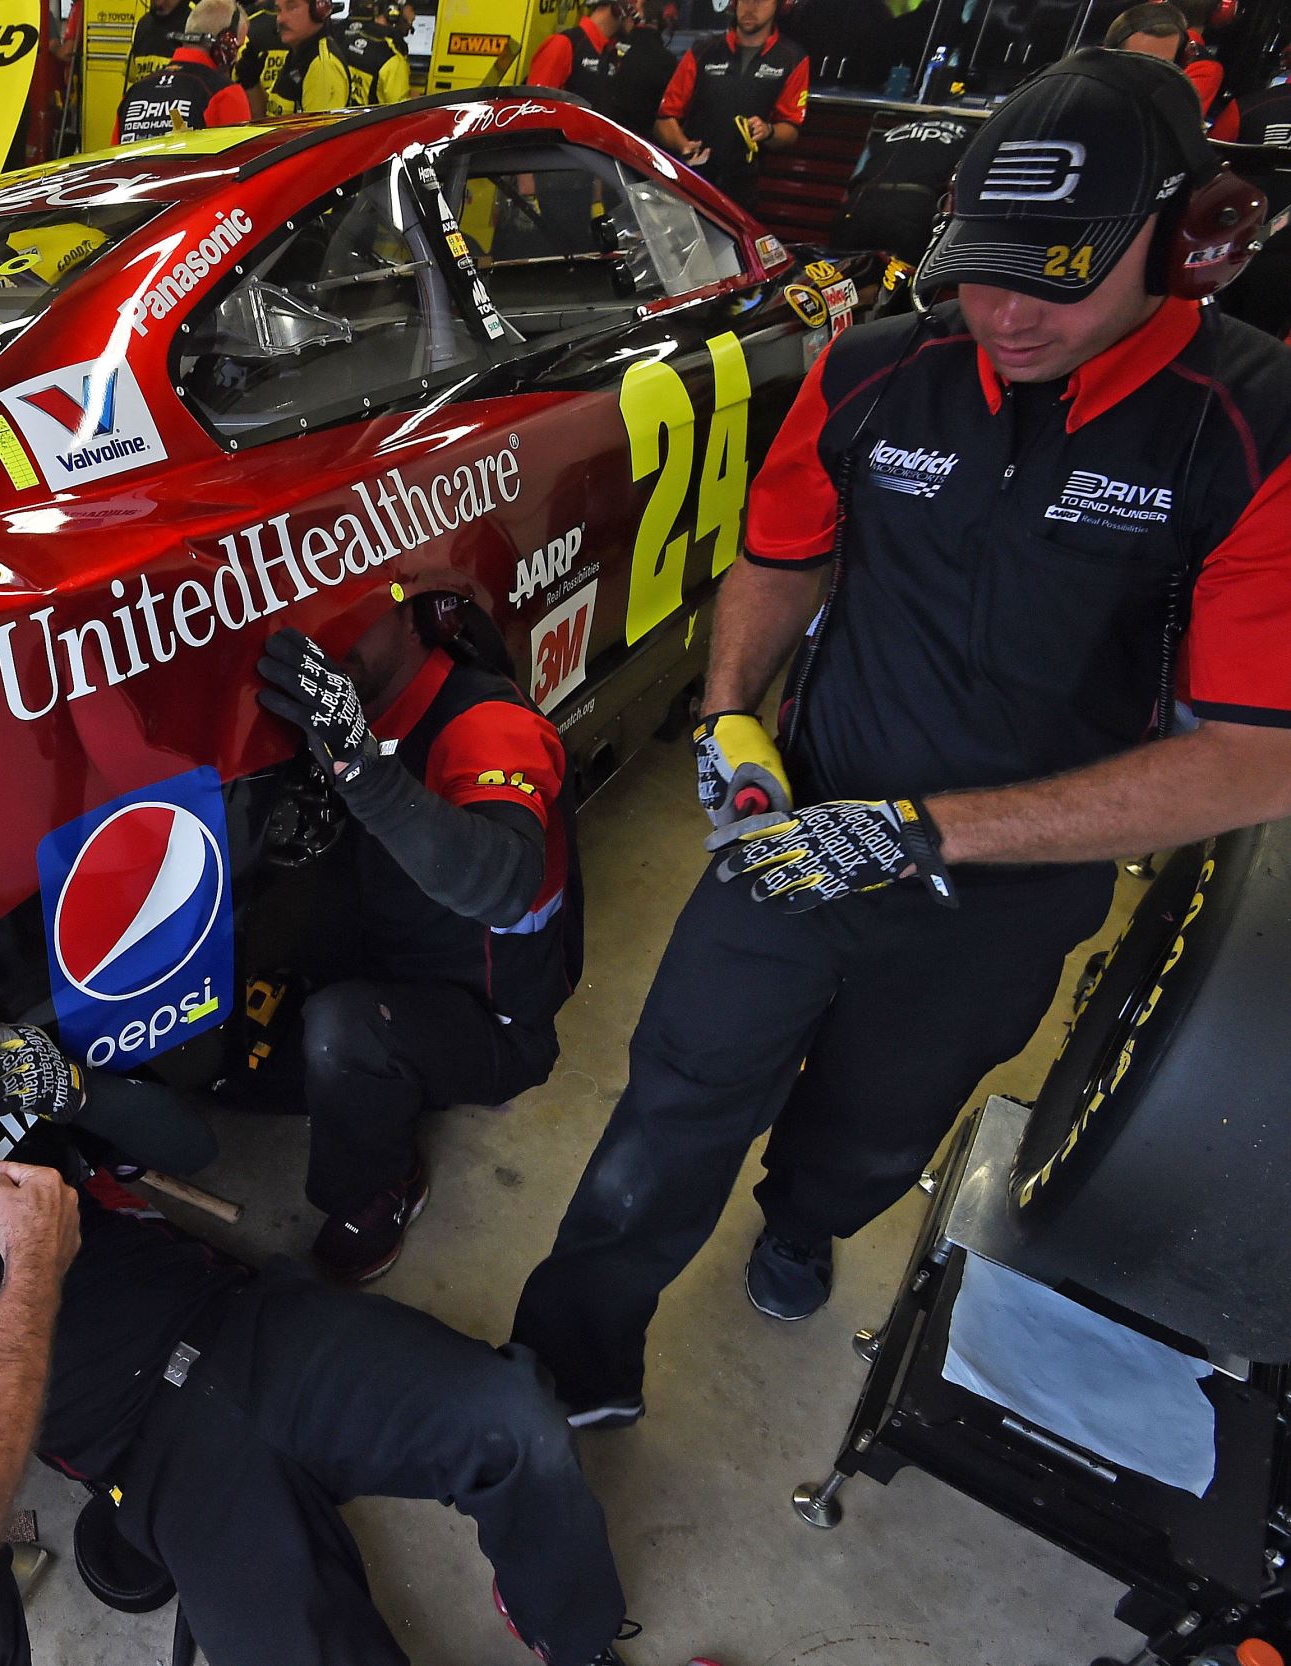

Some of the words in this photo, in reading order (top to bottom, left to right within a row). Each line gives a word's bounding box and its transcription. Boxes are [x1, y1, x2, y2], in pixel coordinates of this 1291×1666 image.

[116, 208, 253, 338] Panasonic
[1042, 245, 1094, 283] 24
[56, 436, 146, 473] Valvoline
[868, 439, 959, 476] Hendrick
[618, 330, 752, 648] 24
[1060, 495, 1079, 507] TO
[1079, 500, 1109, 513] END
[1109, 505, 1168, 523] HUNGER
[1062, 470, 1172, 510] DRIVE
[509, 526, 582, 609] AARP
[546, 586, 561, 607] Real
[562, 561, 600, 593] Possibilities
[534, 603, 588, 706] 3M
[86, 977, 219, 1069] pepsi
